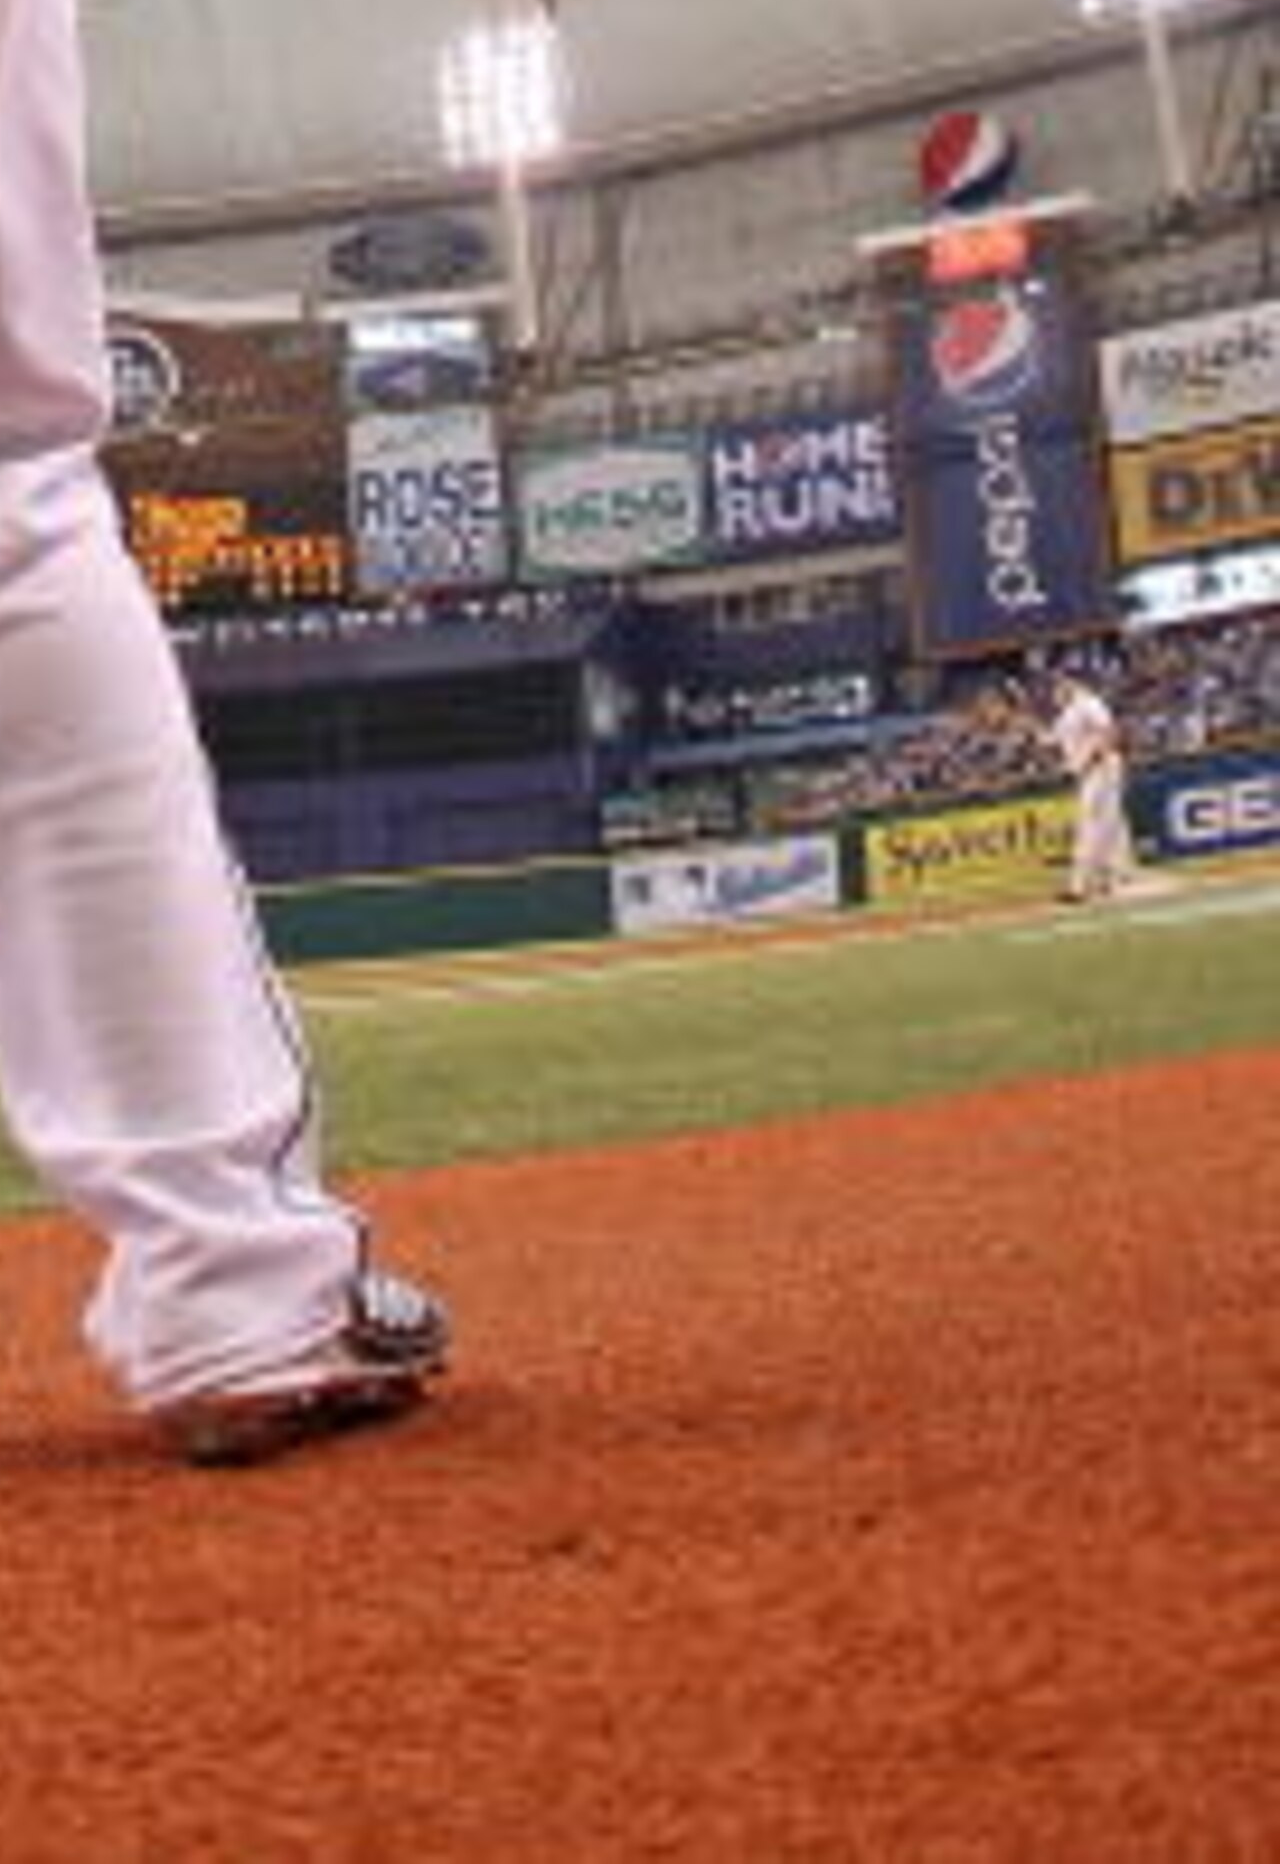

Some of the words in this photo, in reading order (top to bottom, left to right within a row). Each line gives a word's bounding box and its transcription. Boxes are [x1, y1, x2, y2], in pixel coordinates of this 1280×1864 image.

[713, 419, 888, 485] HOME
[356, 459, 502, 531] ROSE
[978, 414, 1048, 611] pepsi
